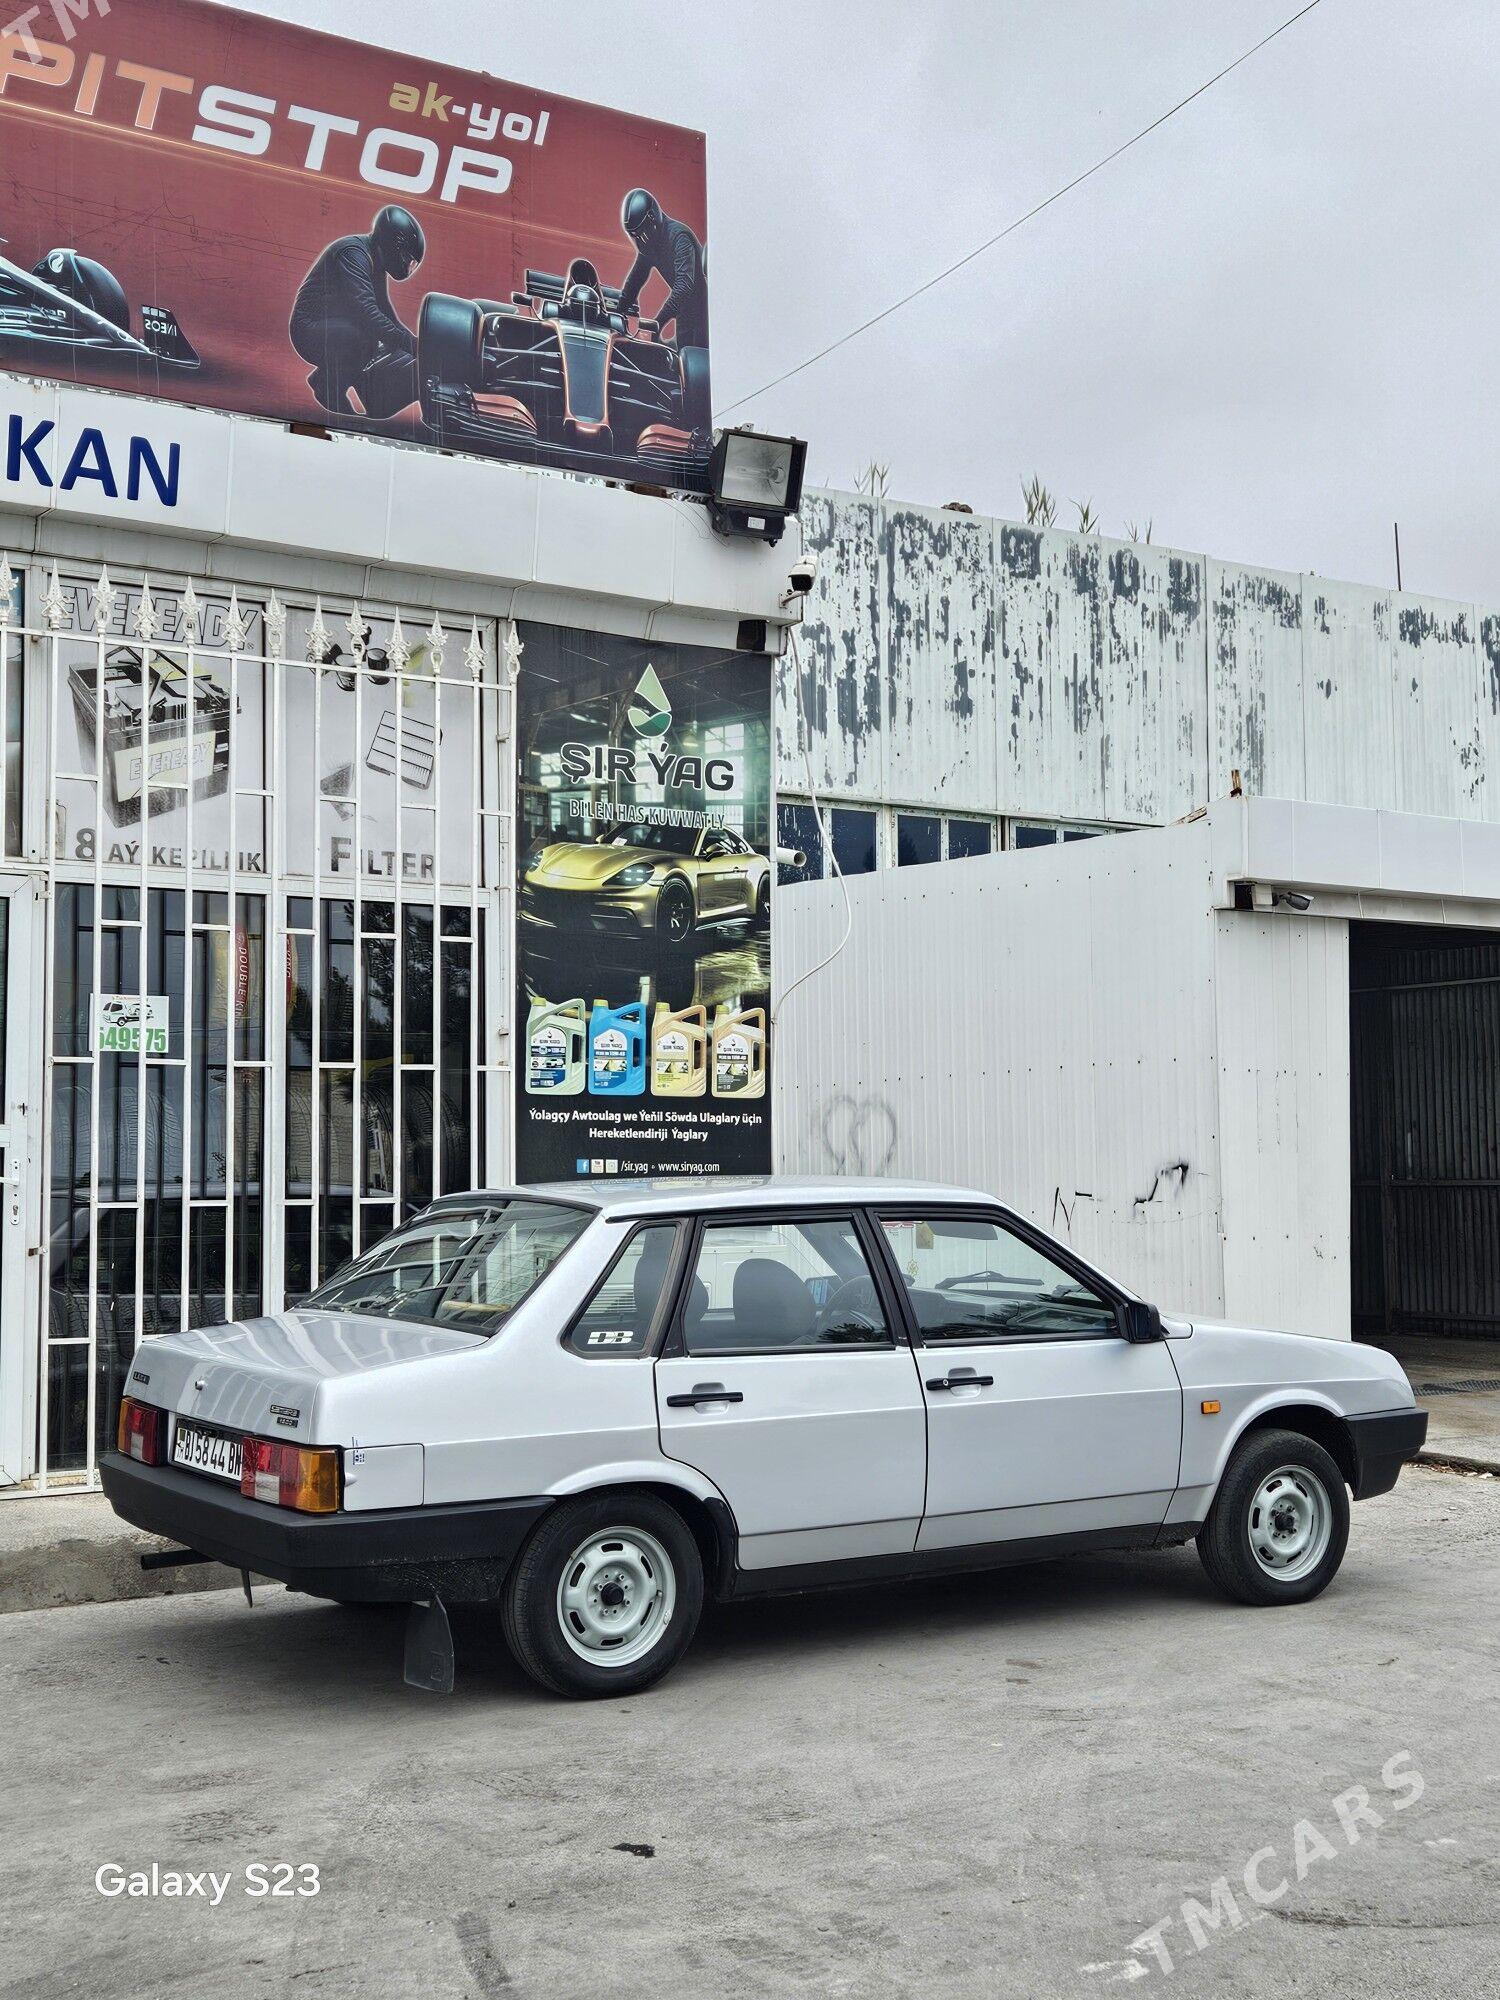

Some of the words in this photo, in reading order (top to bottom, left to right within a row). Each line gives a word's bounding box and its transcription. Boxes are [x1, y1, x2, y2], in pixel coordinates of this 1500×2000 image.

[389, 81, 550, 146] ak-yol
[7, 414, 181, 507] KAN
[129, 743, 209, 781] EEREADY
[561, 742, 637, 784] ŞIR
[647, 742, 735, 791] ÝAG
[569, 798, 614, 820] BILEN
[617, 803, 645, 824] HAS
[75, 827, 96, 859] 8
[330, 836, 435, 879] FLTER
[529, 1109, 570, 1124] Ýolagçy
[572, 1111, 621, 1123] Awtoulag
[623, 1114, 638, 1122] we
[665, 1111, 698, 1122] Söwda
[700, 1112, 740, 1125] Ulaglary
[742, 1114, 762, 1126] üçin
[589, 1128, 668, 1140] Hereketlendiriji
[672, 1127, 708, 1141] Ýaglary
[658, 1161, 720, 1174] www.siryag.com
